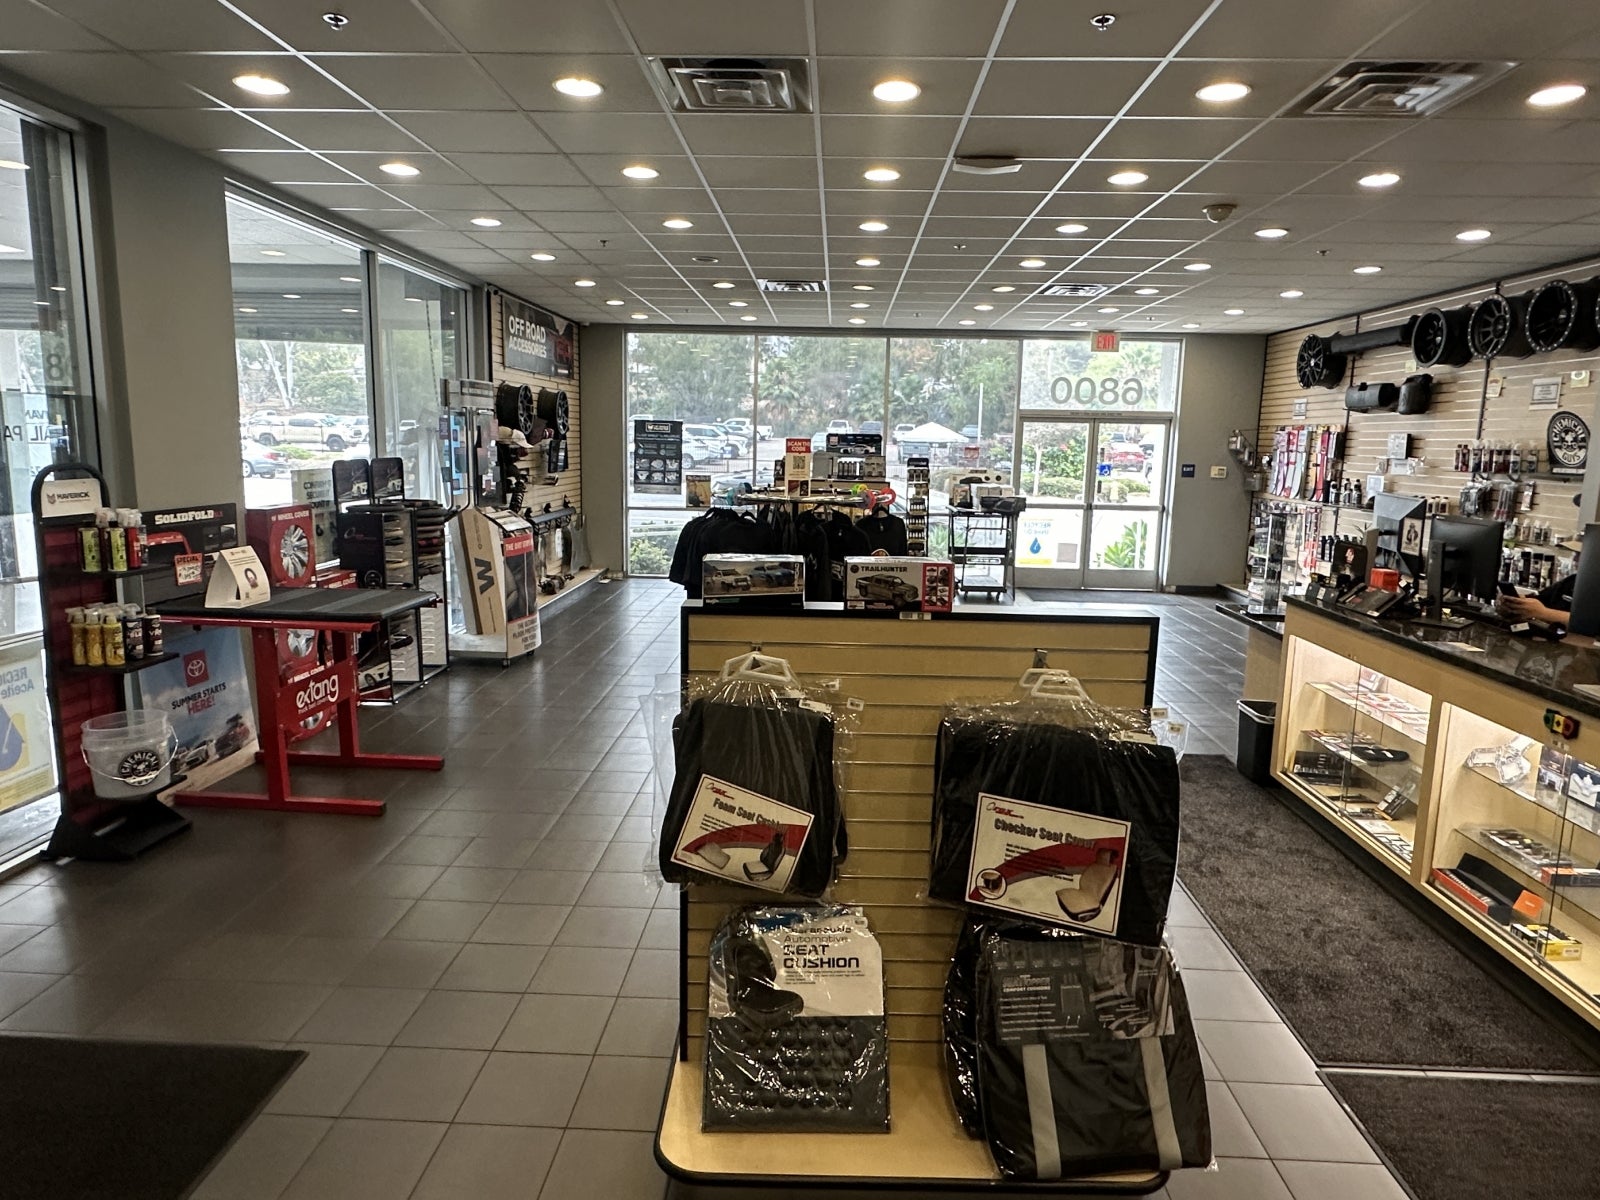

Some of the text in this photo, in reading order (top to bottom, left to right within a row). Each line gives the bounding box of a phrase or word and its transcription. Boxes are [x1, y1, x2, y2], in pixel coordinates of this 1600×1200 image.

[508, 316, 546, 344] OFF ROAD
[508, 336, 547, 358] ACCESSORIES
[1096, 334, 1116, 350] EXIT
[1552, 418, 1586, 441] CHEMICAL
[1562, 452, 1580, 463] GUYS
[56, 492, 90, 500] MAVERICK
[154, 510, 214, 525] SOLIDFOLD
[278, 512, 294, 520] WHEEL
[294, 510, 310, 518] COVER
[171, 682, 226, 710] SUMMER STARTS
[296, 674, 339, 708] extang
[187, 696, 216, 715] HERE!
[712, 797, 737, 815] Foam
[736, 806, 756, 822] Seat
[994, 818, 1038, 838] Checker
[1039, 827, 1063, 844] Seat
[784, 935, 848, 943] Automotive
[784, 944, 830, 956] SEAT
[784, 958, 860, 968] CUSHION
